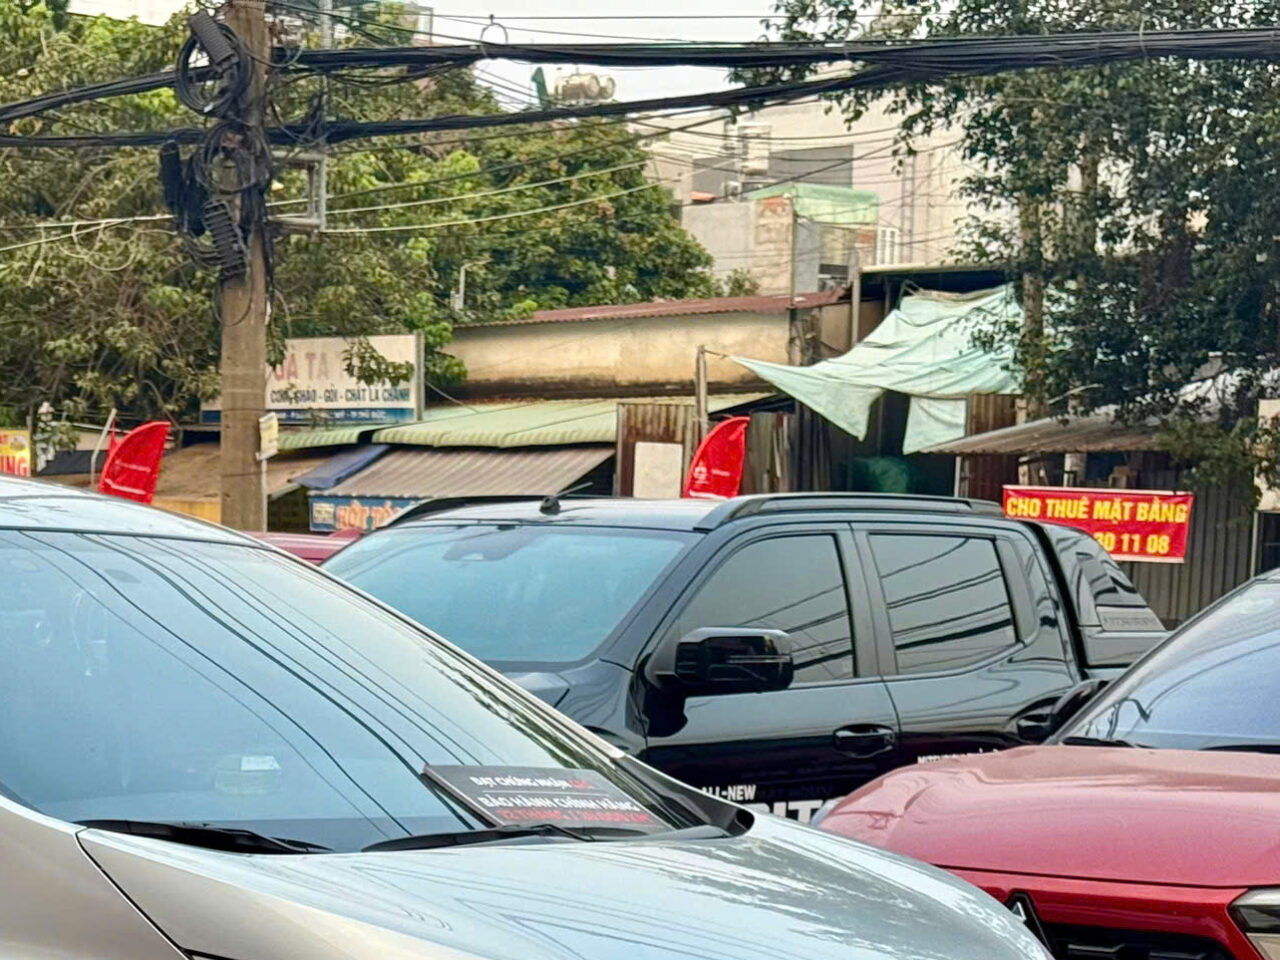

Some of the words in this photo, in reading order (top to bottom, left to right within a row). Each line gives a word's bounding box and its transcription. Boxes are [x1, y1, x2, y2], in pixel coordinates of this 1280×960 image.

[1006, 497, 1041, 518] CHO
[1045, 495, 1089, 519] THUÊ
[1092, 498, 1133, 524] MẶT
[1136, 496, 1187, 522] BẰNG
[1120, 533, 1141, 553] 11
[1147, 534, 1170, 554] 08
[477, 794, 516, 808] BẢO
[509, 794, 558, 808] HÀNH
[553, 796, 598, 809] CHÍNH
